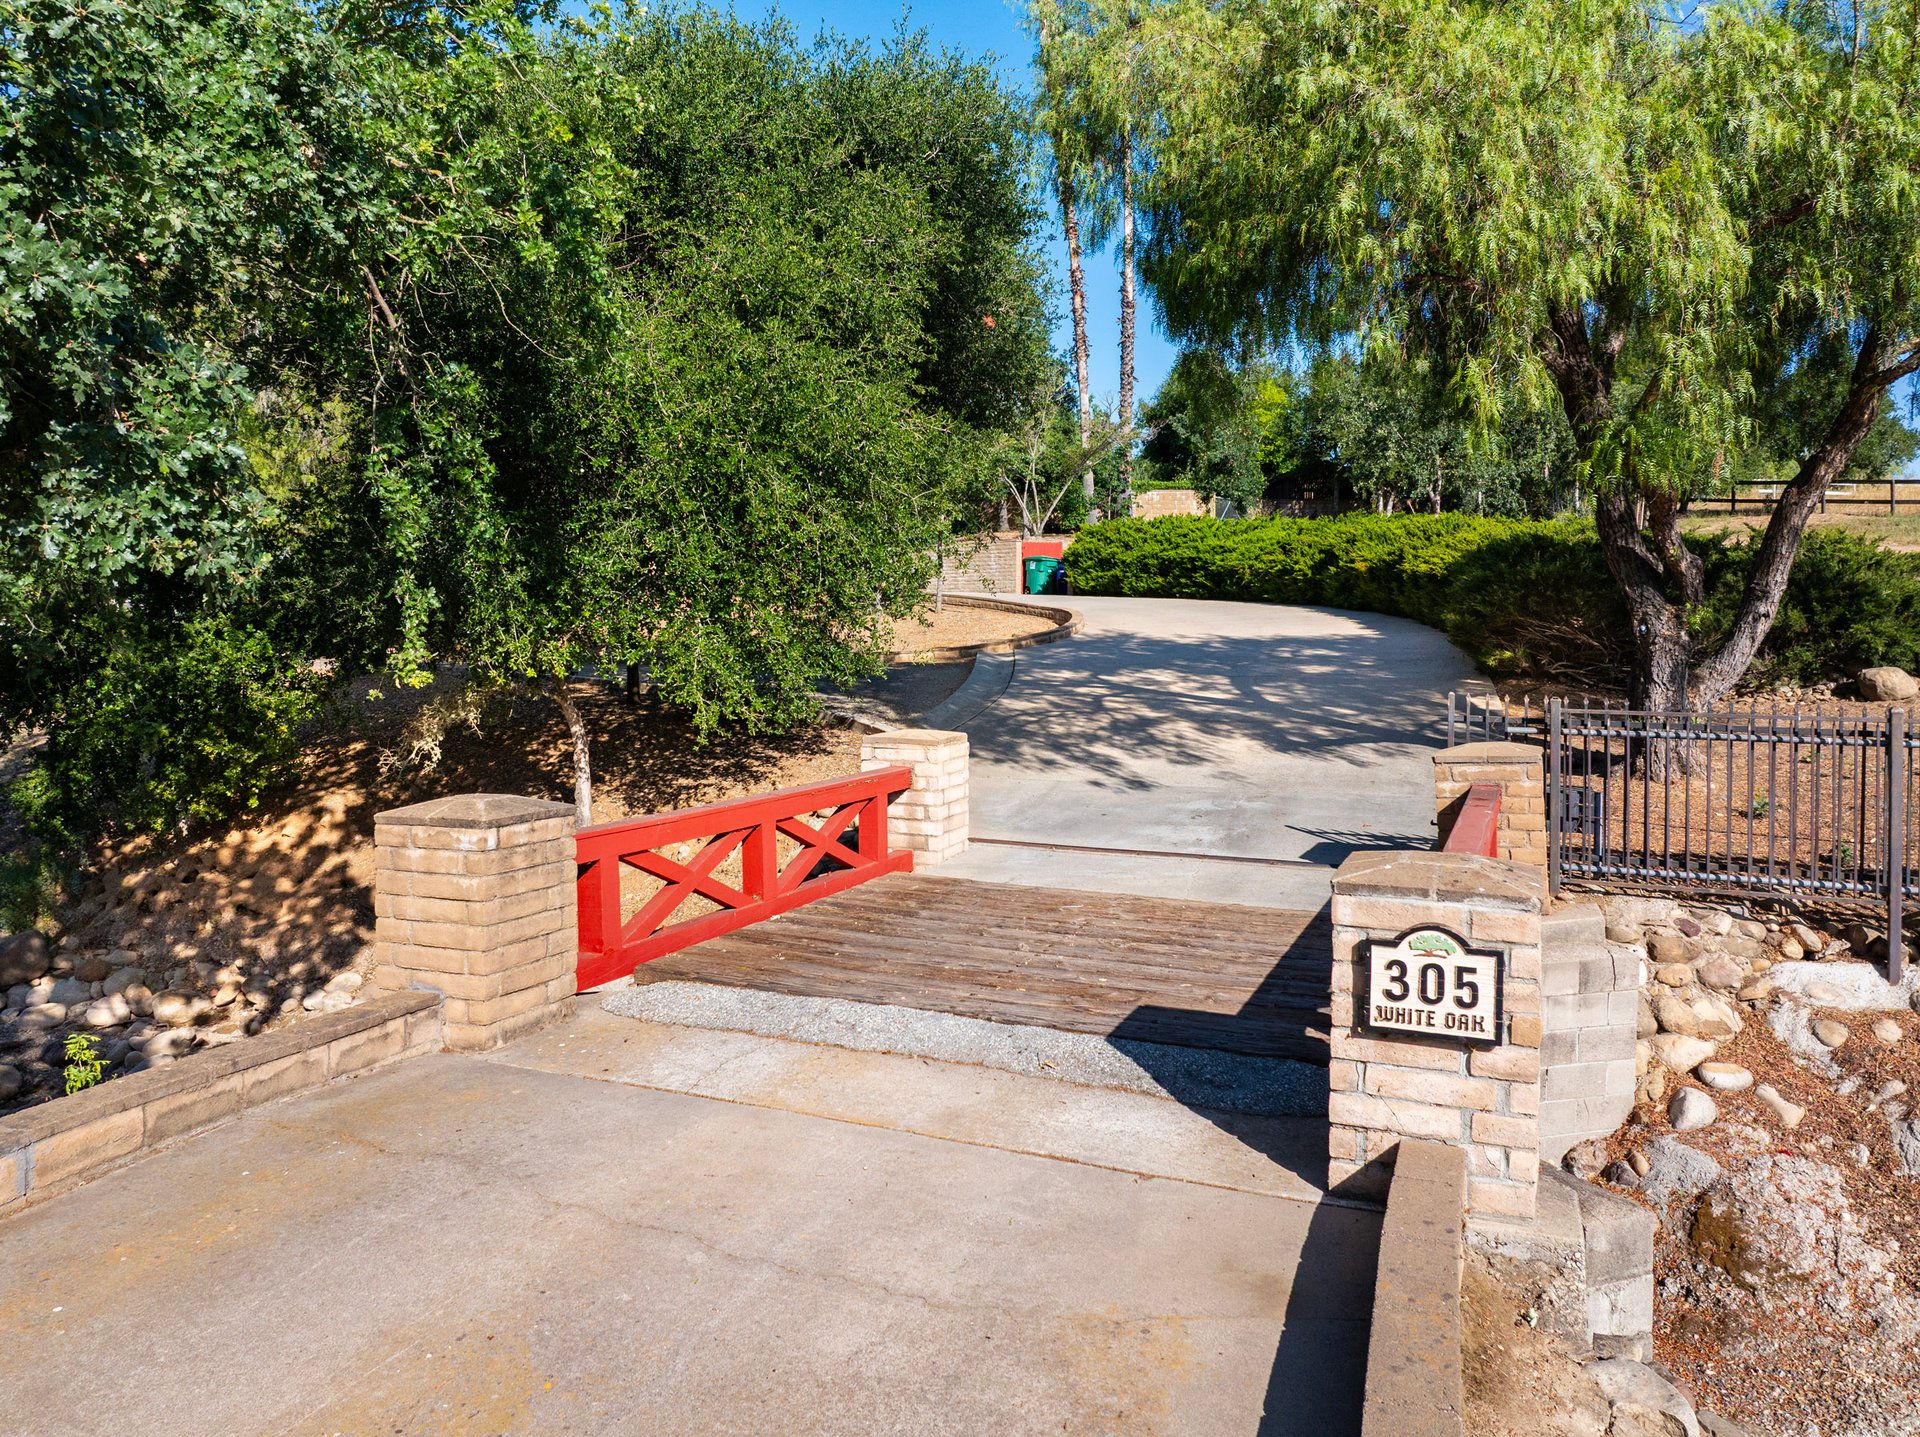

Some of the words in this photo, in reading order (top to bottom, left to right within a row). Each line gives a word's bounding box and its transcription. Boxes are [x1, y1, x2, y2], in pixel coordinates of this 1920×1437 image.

[1382, 959, 1479, 1009] 305
[1374, 1005, 1436, 1027] WHITE
[1444, 1013, 1486, 1033] OAK
